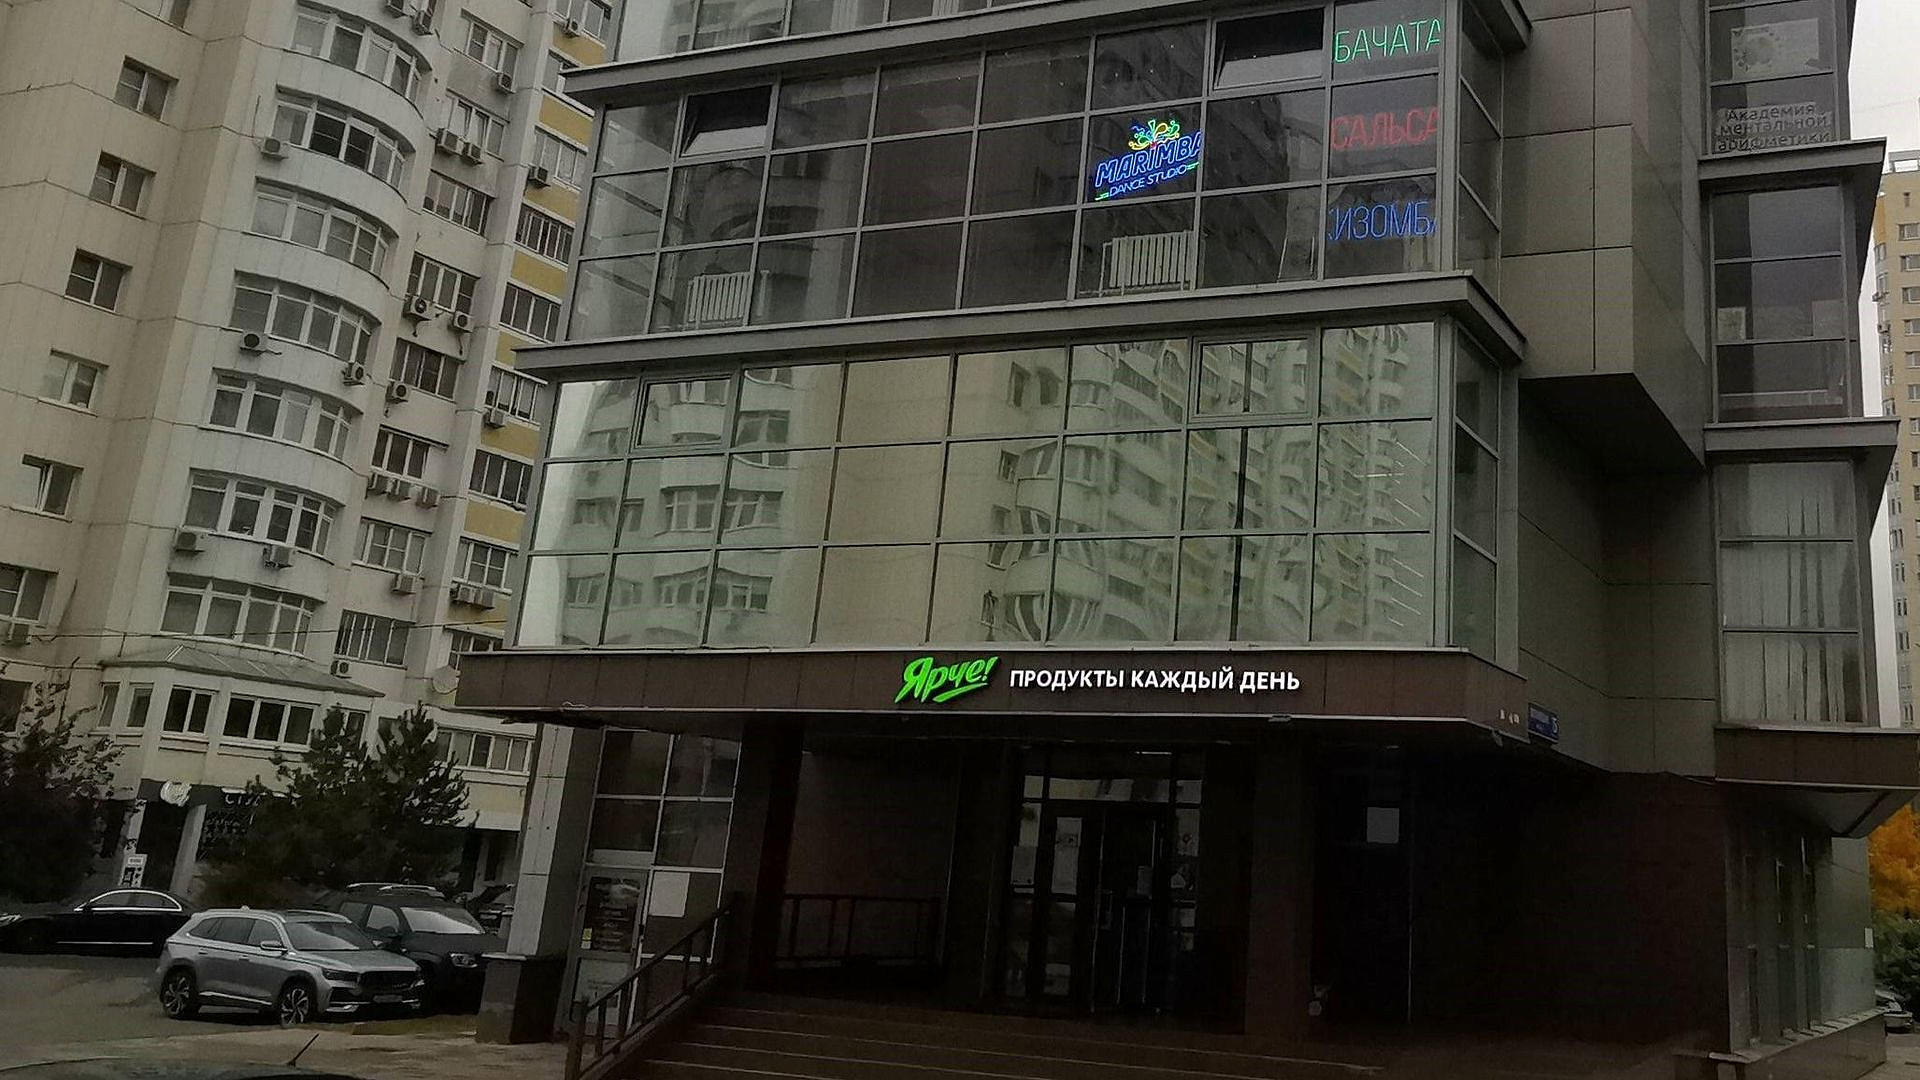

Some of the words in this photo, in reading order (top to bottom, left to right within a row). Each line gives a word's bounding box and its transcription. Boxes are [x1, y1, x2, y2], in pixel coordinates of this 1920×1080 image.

[1334, 18, 1441, 63] БАЧАТА
[1331, 105, 1439, 150] САЛЬСА
[1727, 104, 1816, 122] Академия
[1109, 178, 1146, 197] DANCE
[1146, 164, 1188, 185] STUDIO
[1328, 201, 1437, 241] ИЗОМБ
[895, 656, 999, 703] Ярче!
[1009, 669, 1125, 692] ПРОДУКТЫ
[1131, 665, 1234, 693] КАЖДЫЙ
[1239, 671, 1301, 694] ДЕНЬ
